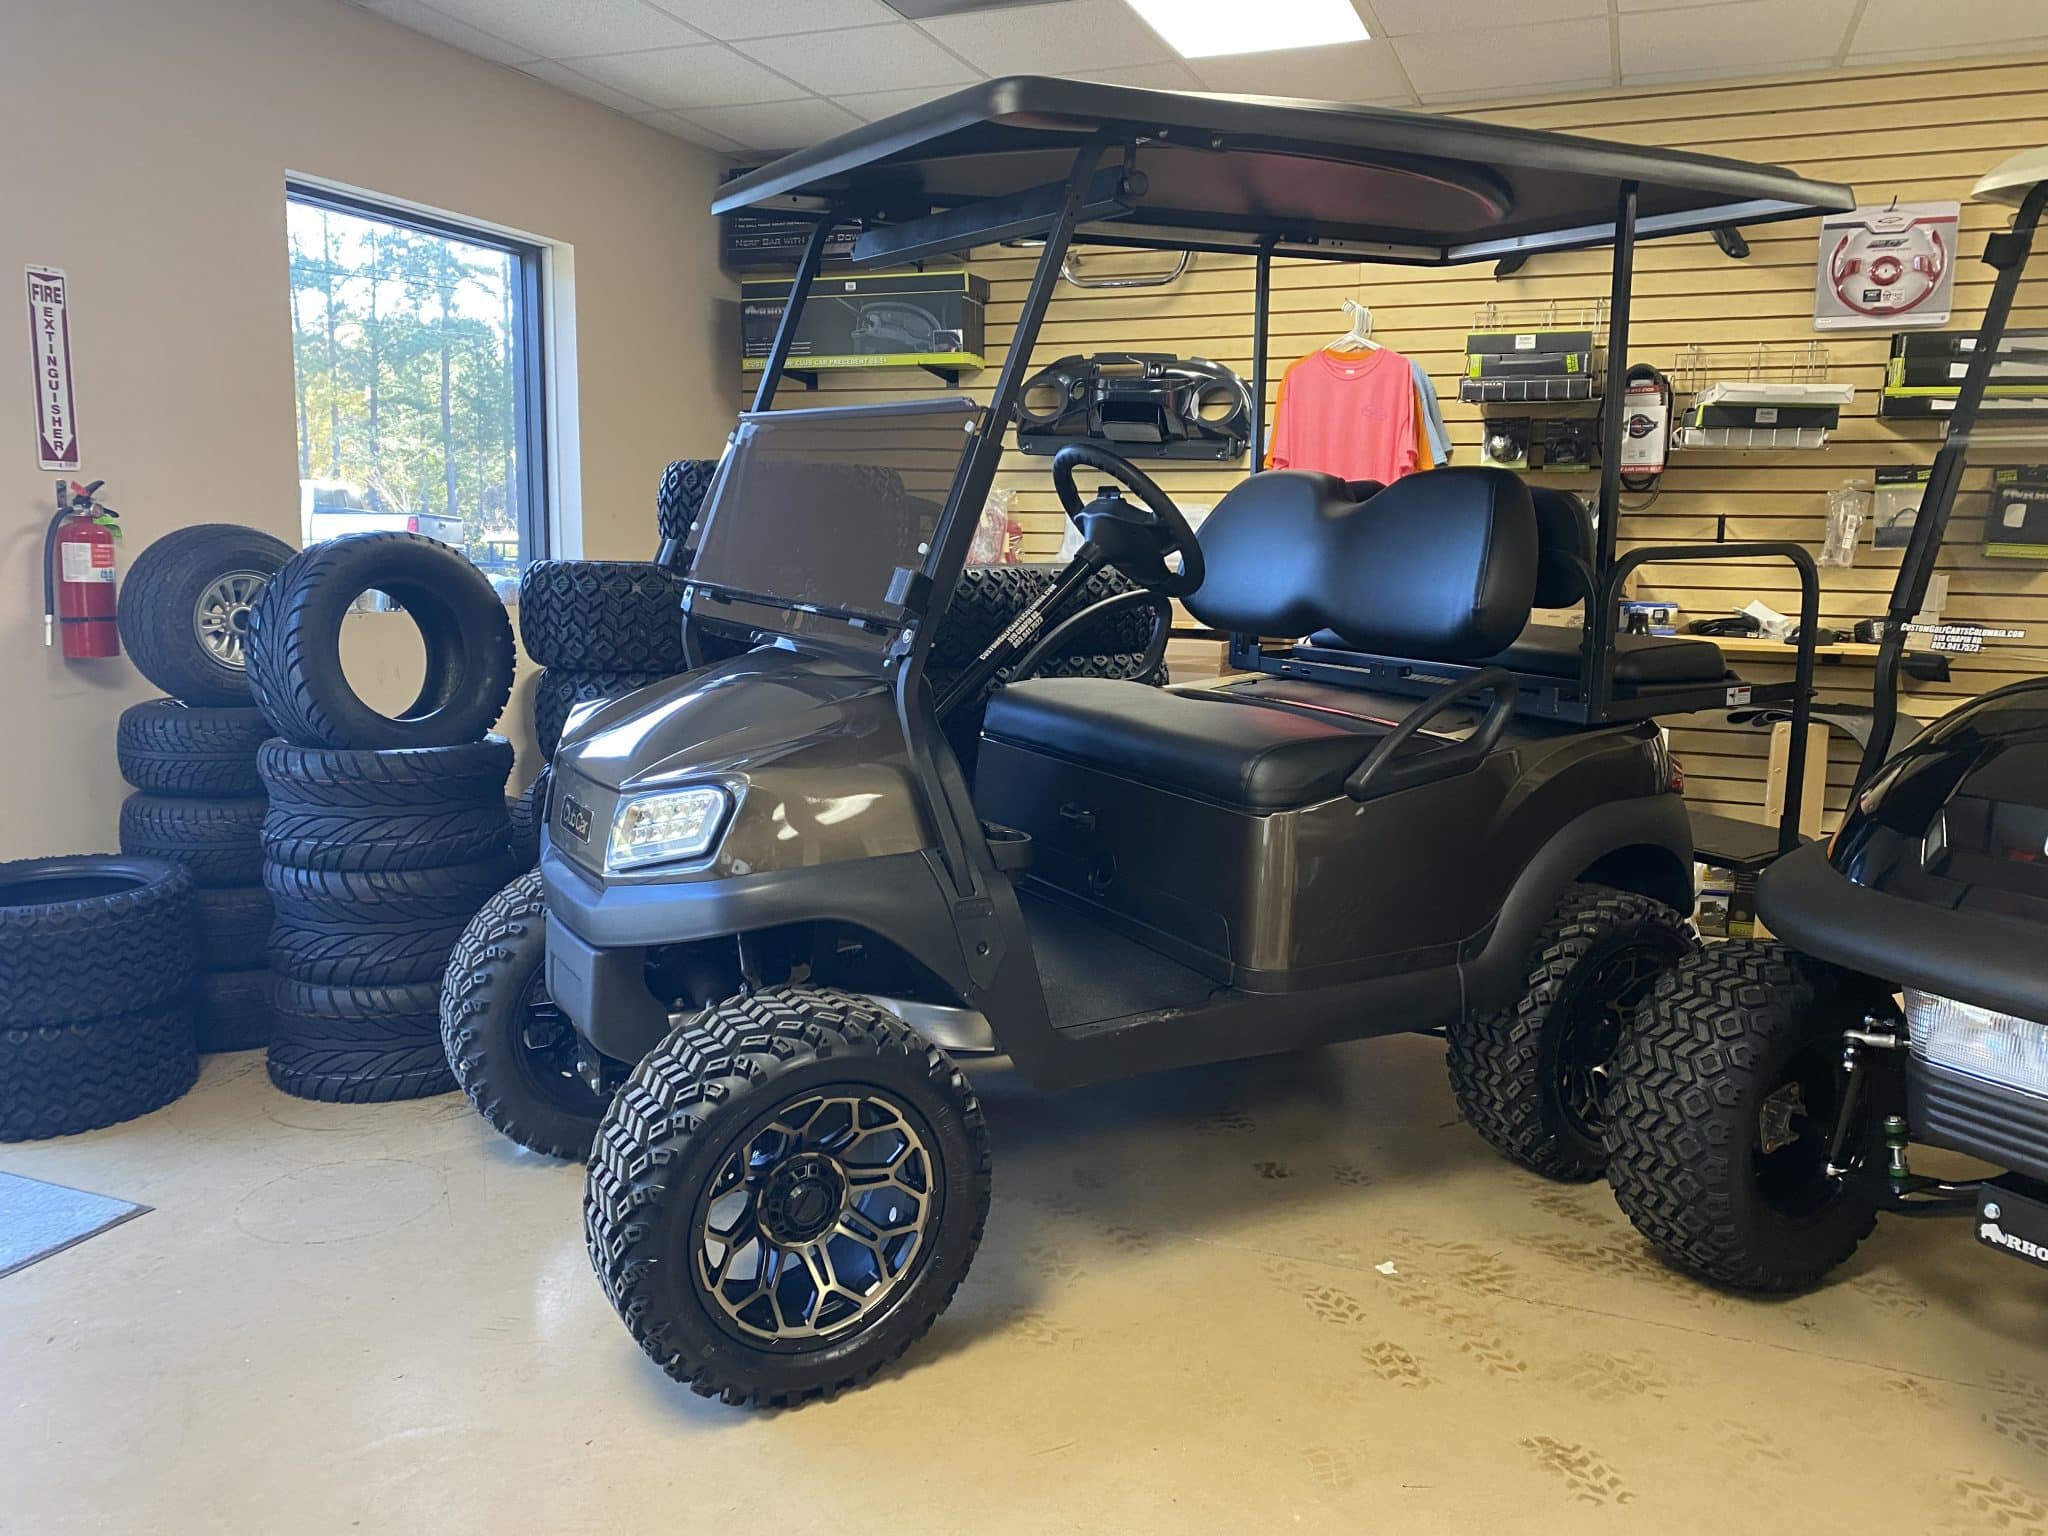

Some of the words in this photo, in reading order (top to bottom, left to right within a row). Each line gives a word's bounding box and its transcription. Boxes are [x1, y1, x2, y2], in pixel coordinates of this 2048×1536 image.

[31, 283, 63, 305] FIRE
[43, 306, 64, 451] EXTINGUISHER
[1933, 634, 1946, 642] 519
